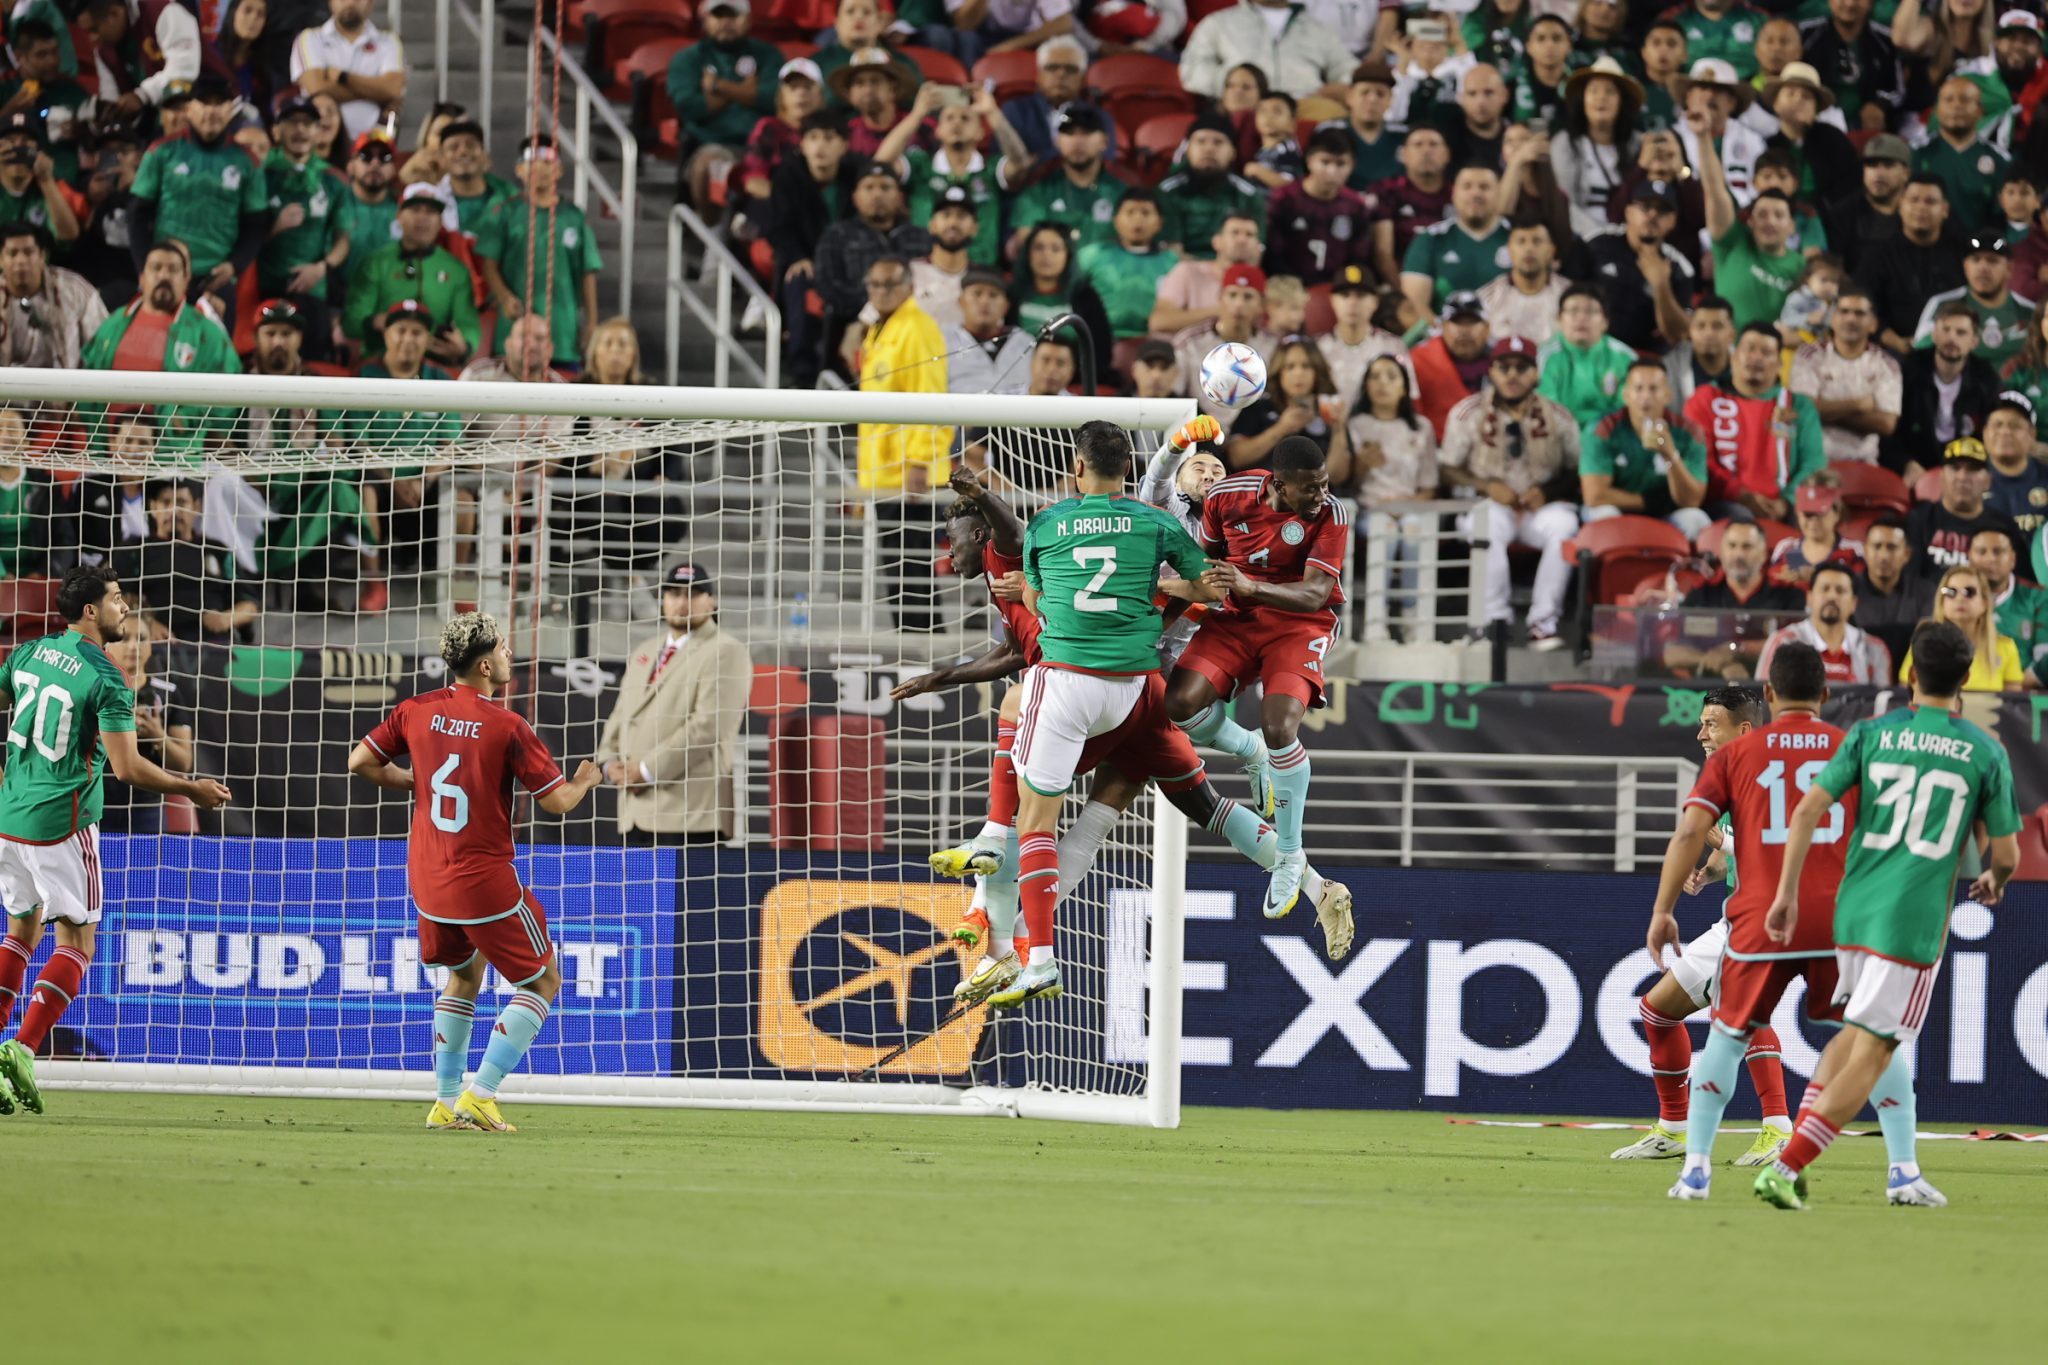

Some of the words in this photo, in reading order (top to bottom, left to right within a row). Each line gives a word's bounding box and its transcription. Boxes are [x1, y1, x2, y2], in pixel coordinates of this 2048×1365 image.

[1057, 520, 1070, 536] N.
[1073, 517, 1131, 535] ARAUJO
[1248, 547, 1270, 568] 4
[1072, 546, 1118, 612] 2
[1308, 635, 1329, 661] 4
[7, 669, 74, 762] 20
[430, 714, 483, 739] ALZATE
[1767, 733, 1829, 749] FABRA
[1879, 730, 1895, 750] K.
[1897, 727, 1974, 763] ÁLVAREZ
[430, 753, 469, 833] 6
[1861, 762, 1970, 861] 30
[125, 930, 326, 990] BUD
[341, 937, 619, 997] LIT
